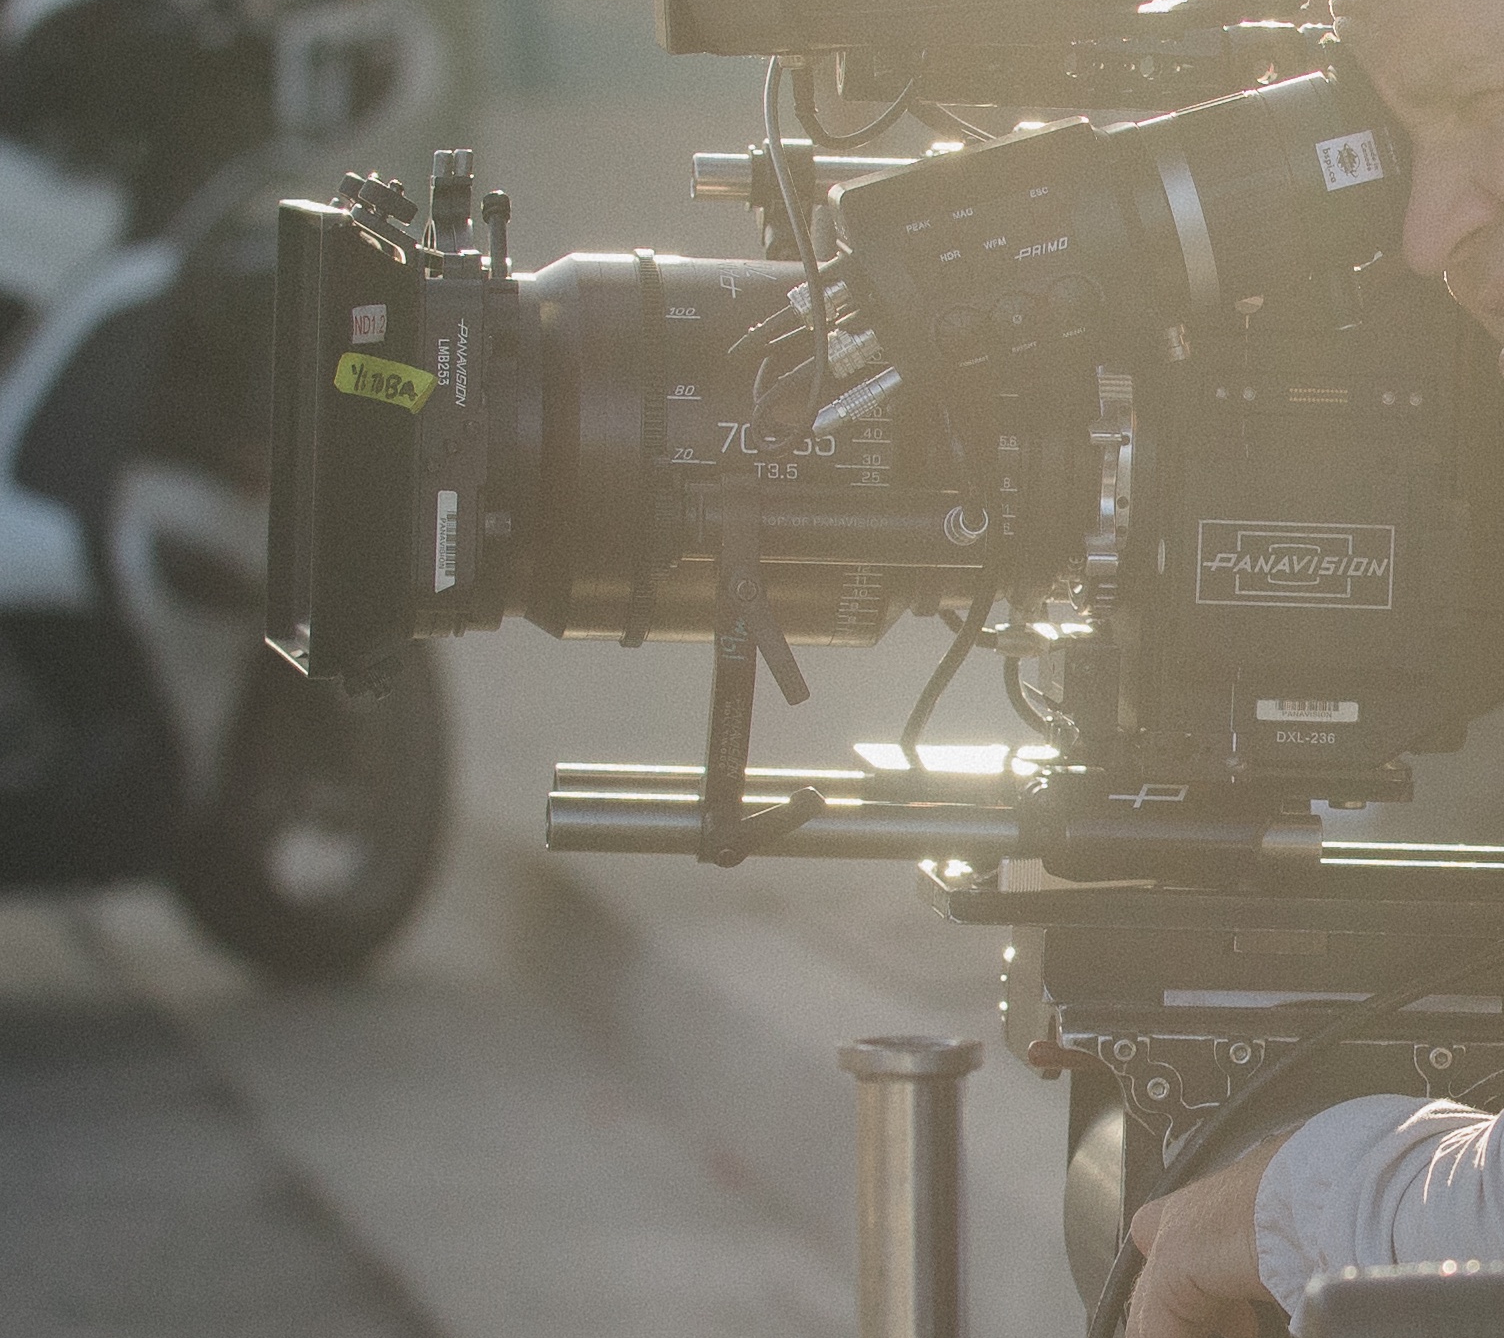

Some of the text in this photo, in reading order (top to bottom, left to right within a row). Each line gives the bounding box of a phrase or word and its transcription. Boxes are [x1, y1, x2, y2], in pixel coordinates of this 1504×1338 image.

[1029, 186, 1049, 198] ESC
[906, 207, 974, 233] PEAK MAG
[1014, 236, 1069, 261] PRIMO
[940, 249, 961, 263] HDR
[669, 306, 696, 316] 100
[354, 314, 386, 335] ND1.2
[437, 338, 450, 386] LMB253
[455, 318, 469, 407] PANAVISION
[674, 385, 695, 396] 80
[863, 428, 883, 439] 40
[999, 435, 1017, 447] 5.6
[674, 448, 694, 459] 70
[862, 454, 881, 465] 30
[753, 462, 798, 479] T3.5
[861, 471, 880, 483] 25
[1003, 477, 1011, 488] 8
[438, 517, 447, 570] PANAVISION
[1203, 552, 1389, 577] PANAVISION
[1281, 710, 1333, 718] PANAVISION
[1276, 731, 1336, 744] DXL-236
